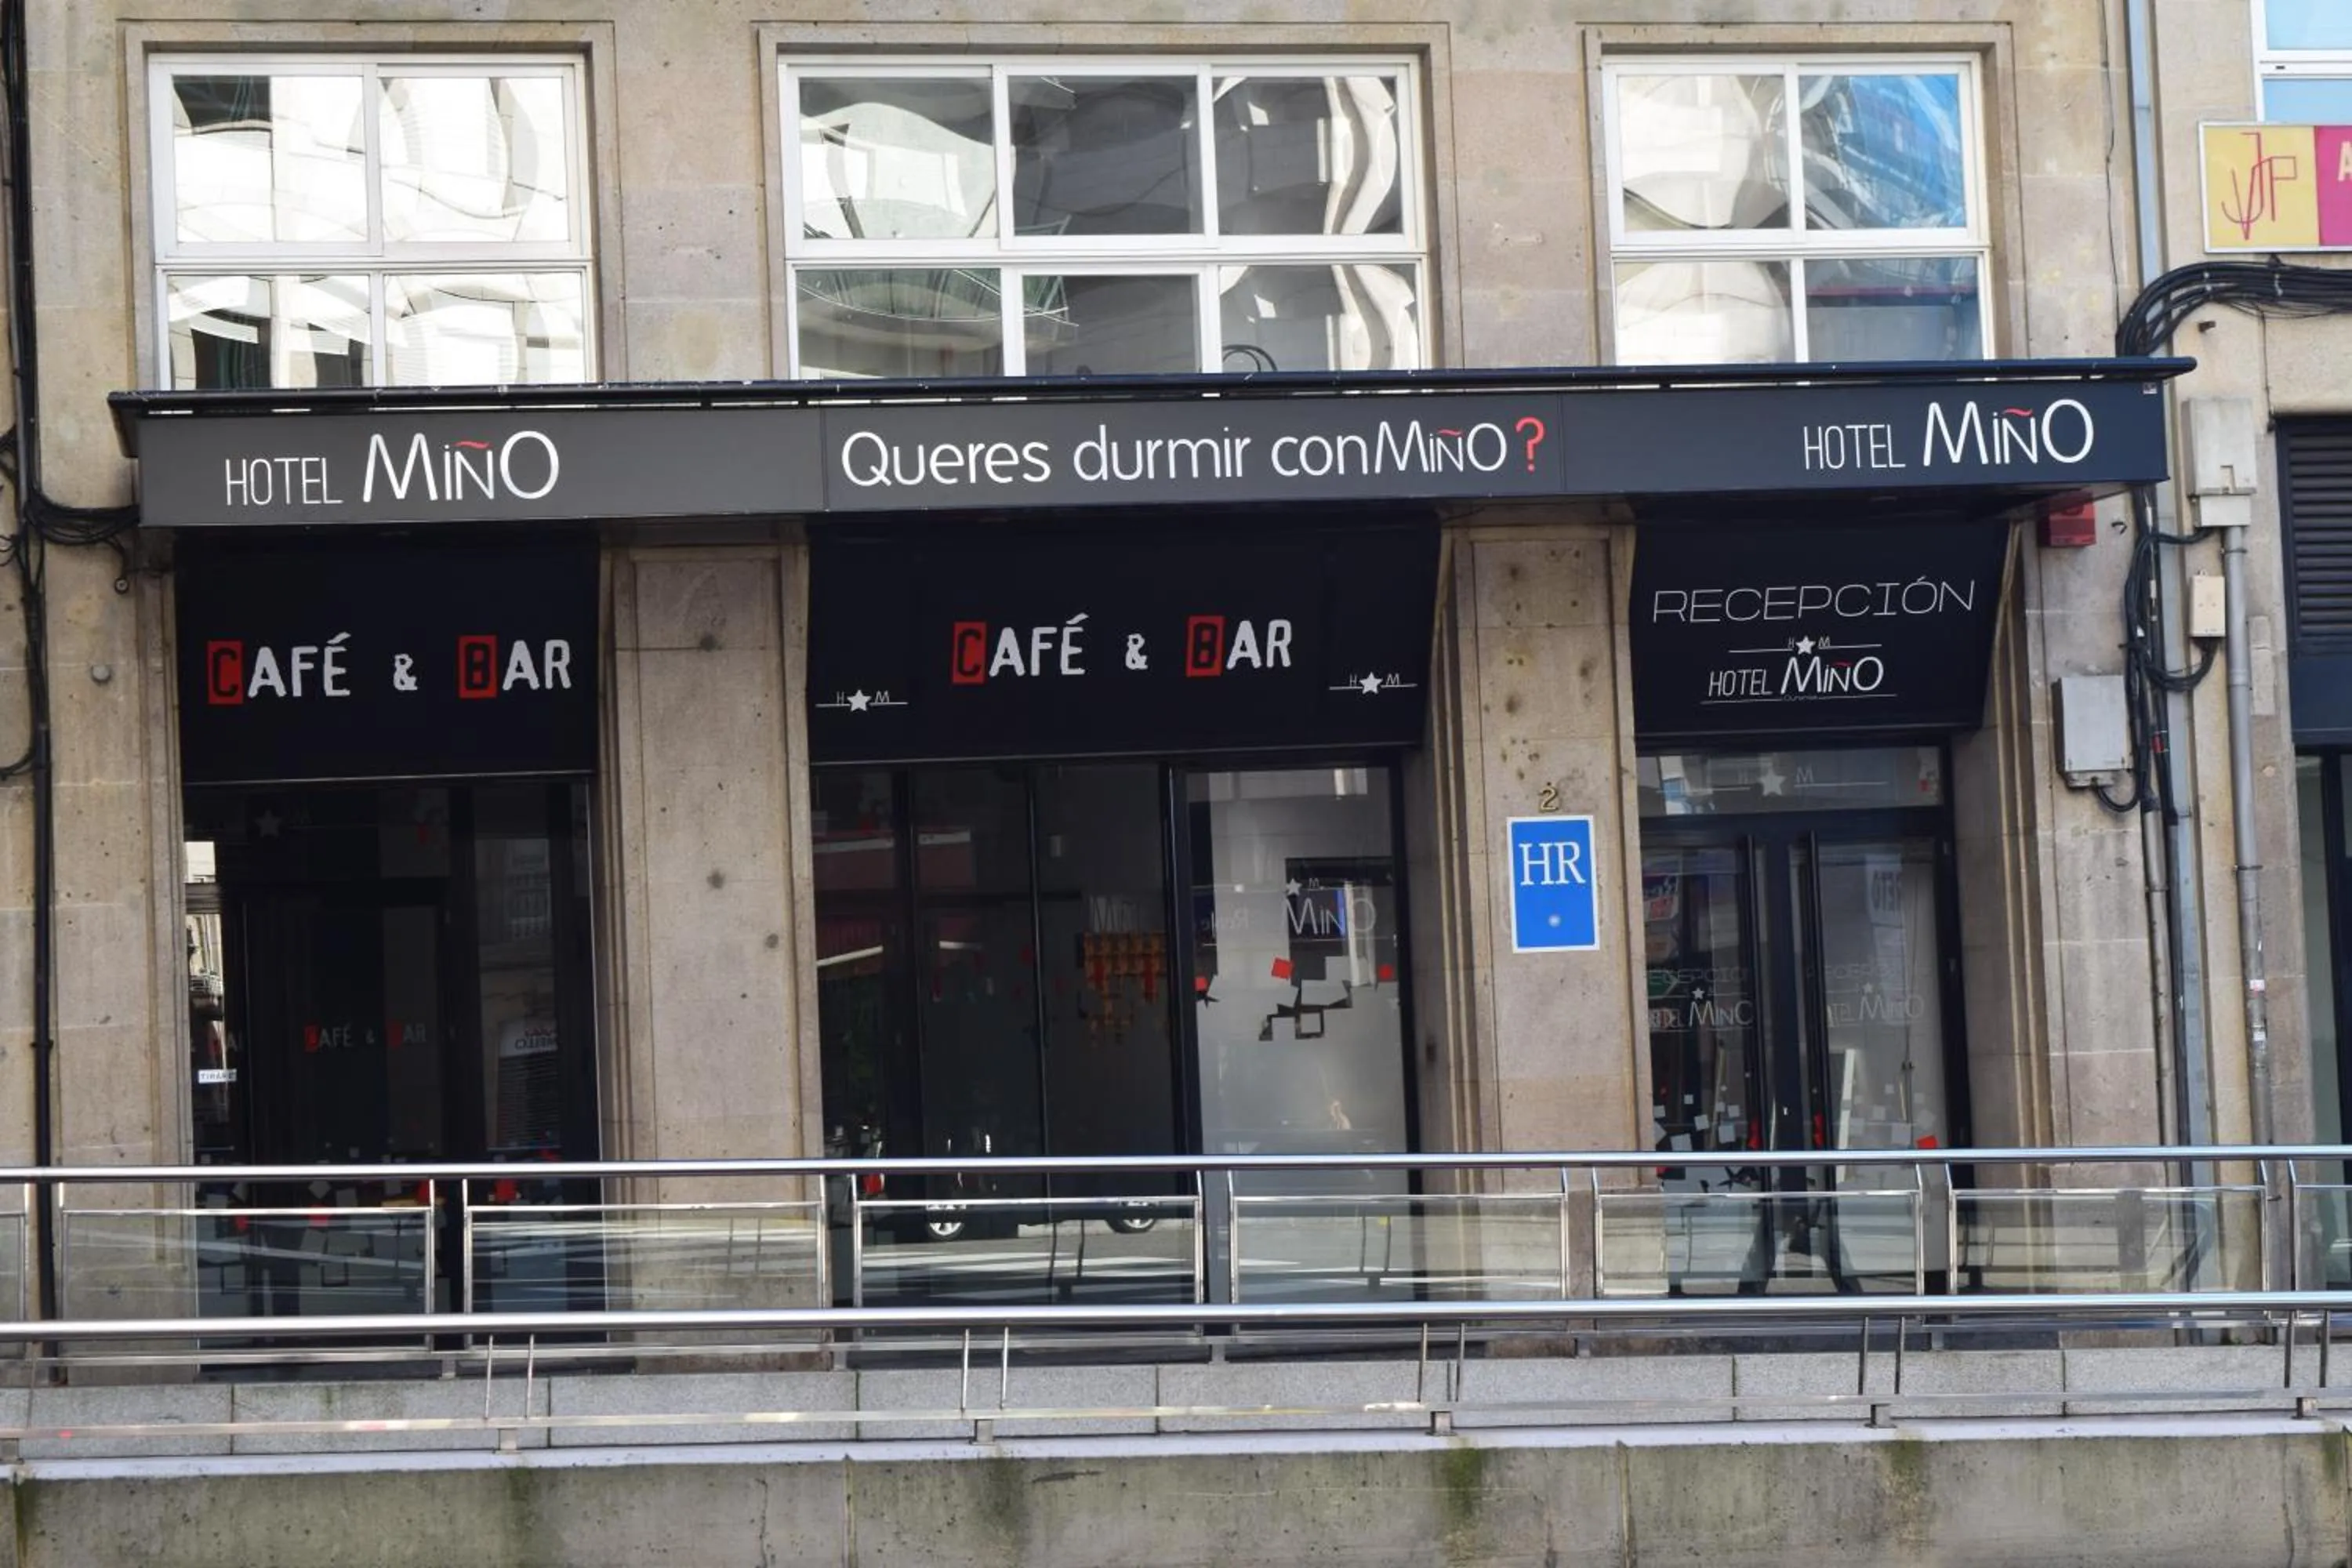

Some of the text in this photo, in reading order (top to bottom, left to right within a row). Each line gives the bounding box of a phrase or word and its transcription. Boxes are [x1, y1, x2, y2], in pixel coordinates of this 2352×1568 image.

[841, 430, 1051, 487] Queres
[1073, 424, 1252, 481] durmir
[1803, 424, 1906, 470] HOTEL
[225, 457, 343, 506] HOTEL
[1653, 575, 1975, 623] RECEPCIÓN
[209, 632, 572, 703] CAFÉ & BAR
[953, 613, 1293, 683] CAFÉ & BAR
[1708, 669, 1773, 696] HOTEL
[1540, 786, 1558, 812] 2
[1519, 840, 1586, 886] HR
